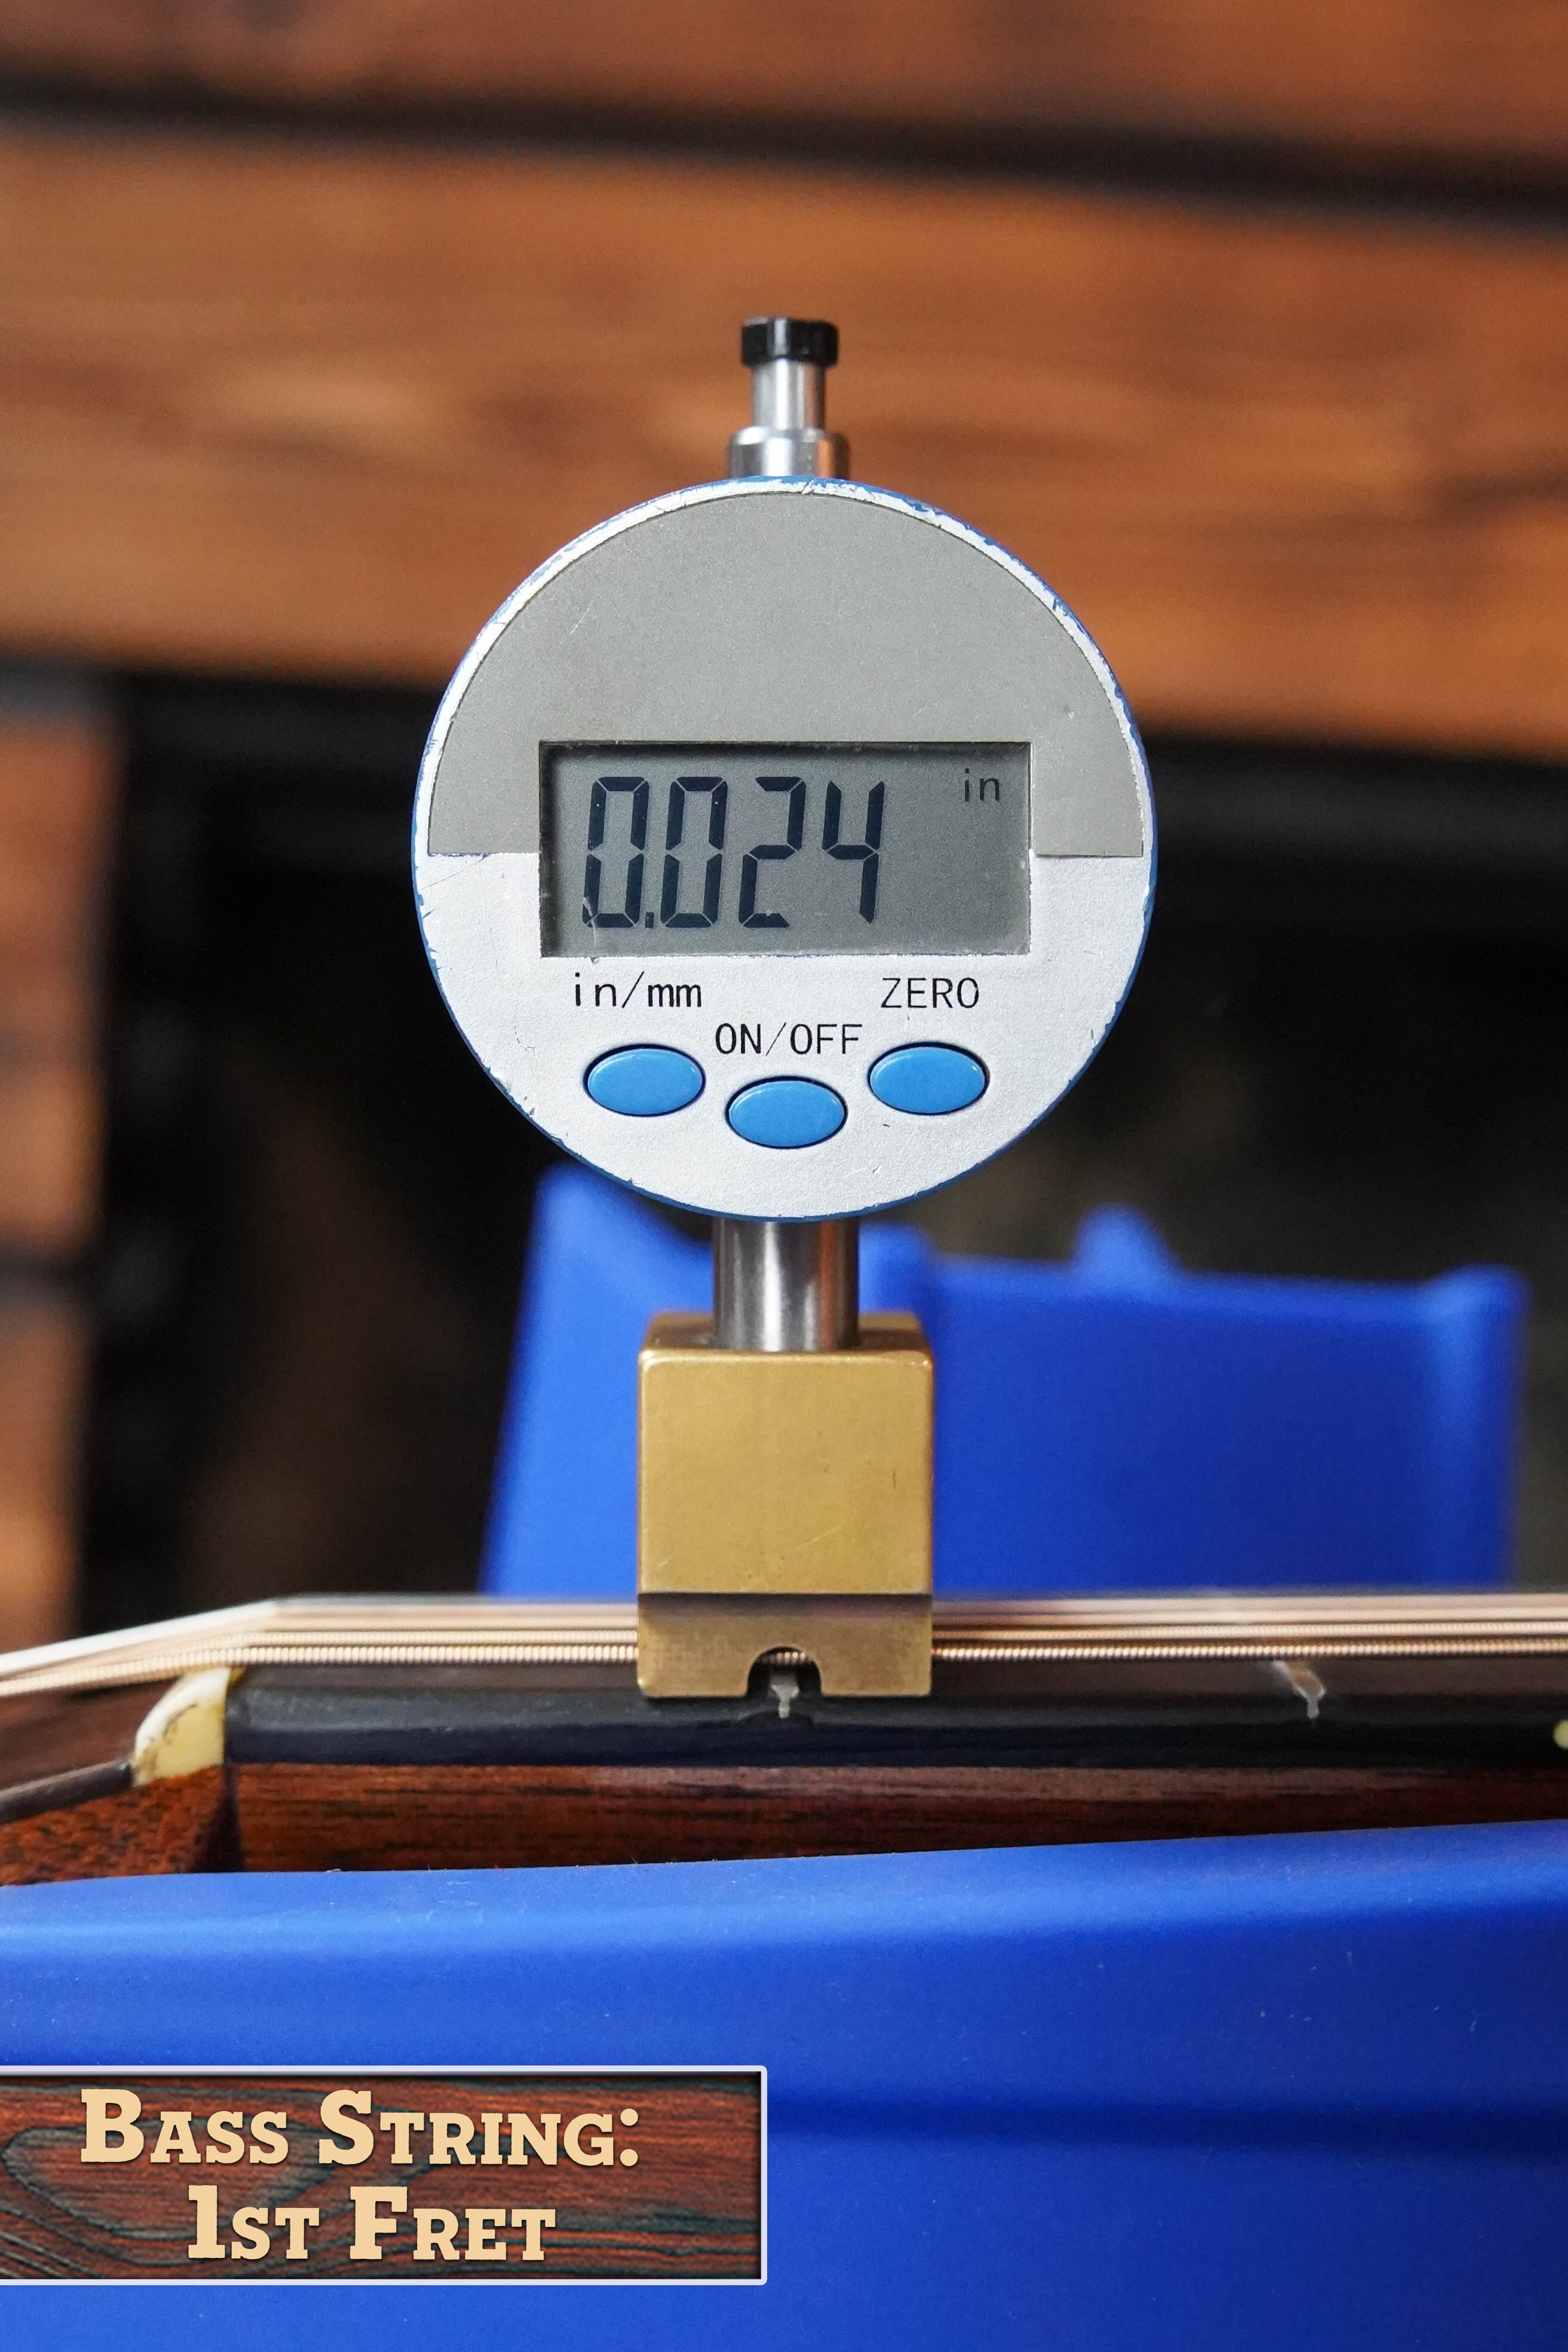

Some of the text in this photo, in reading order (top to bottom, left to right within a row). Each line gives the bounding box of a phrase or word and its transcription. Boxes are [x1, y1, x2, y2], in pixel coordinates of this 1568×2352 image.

[963, 768, 1002, 801] in
[582, 776, 885, 928] 0.024
[574, 971, 703, 1009] in/mm
[881, 977, 980, 1009] ZERO
[715, 1022, 863, 1056] ON/OFF
